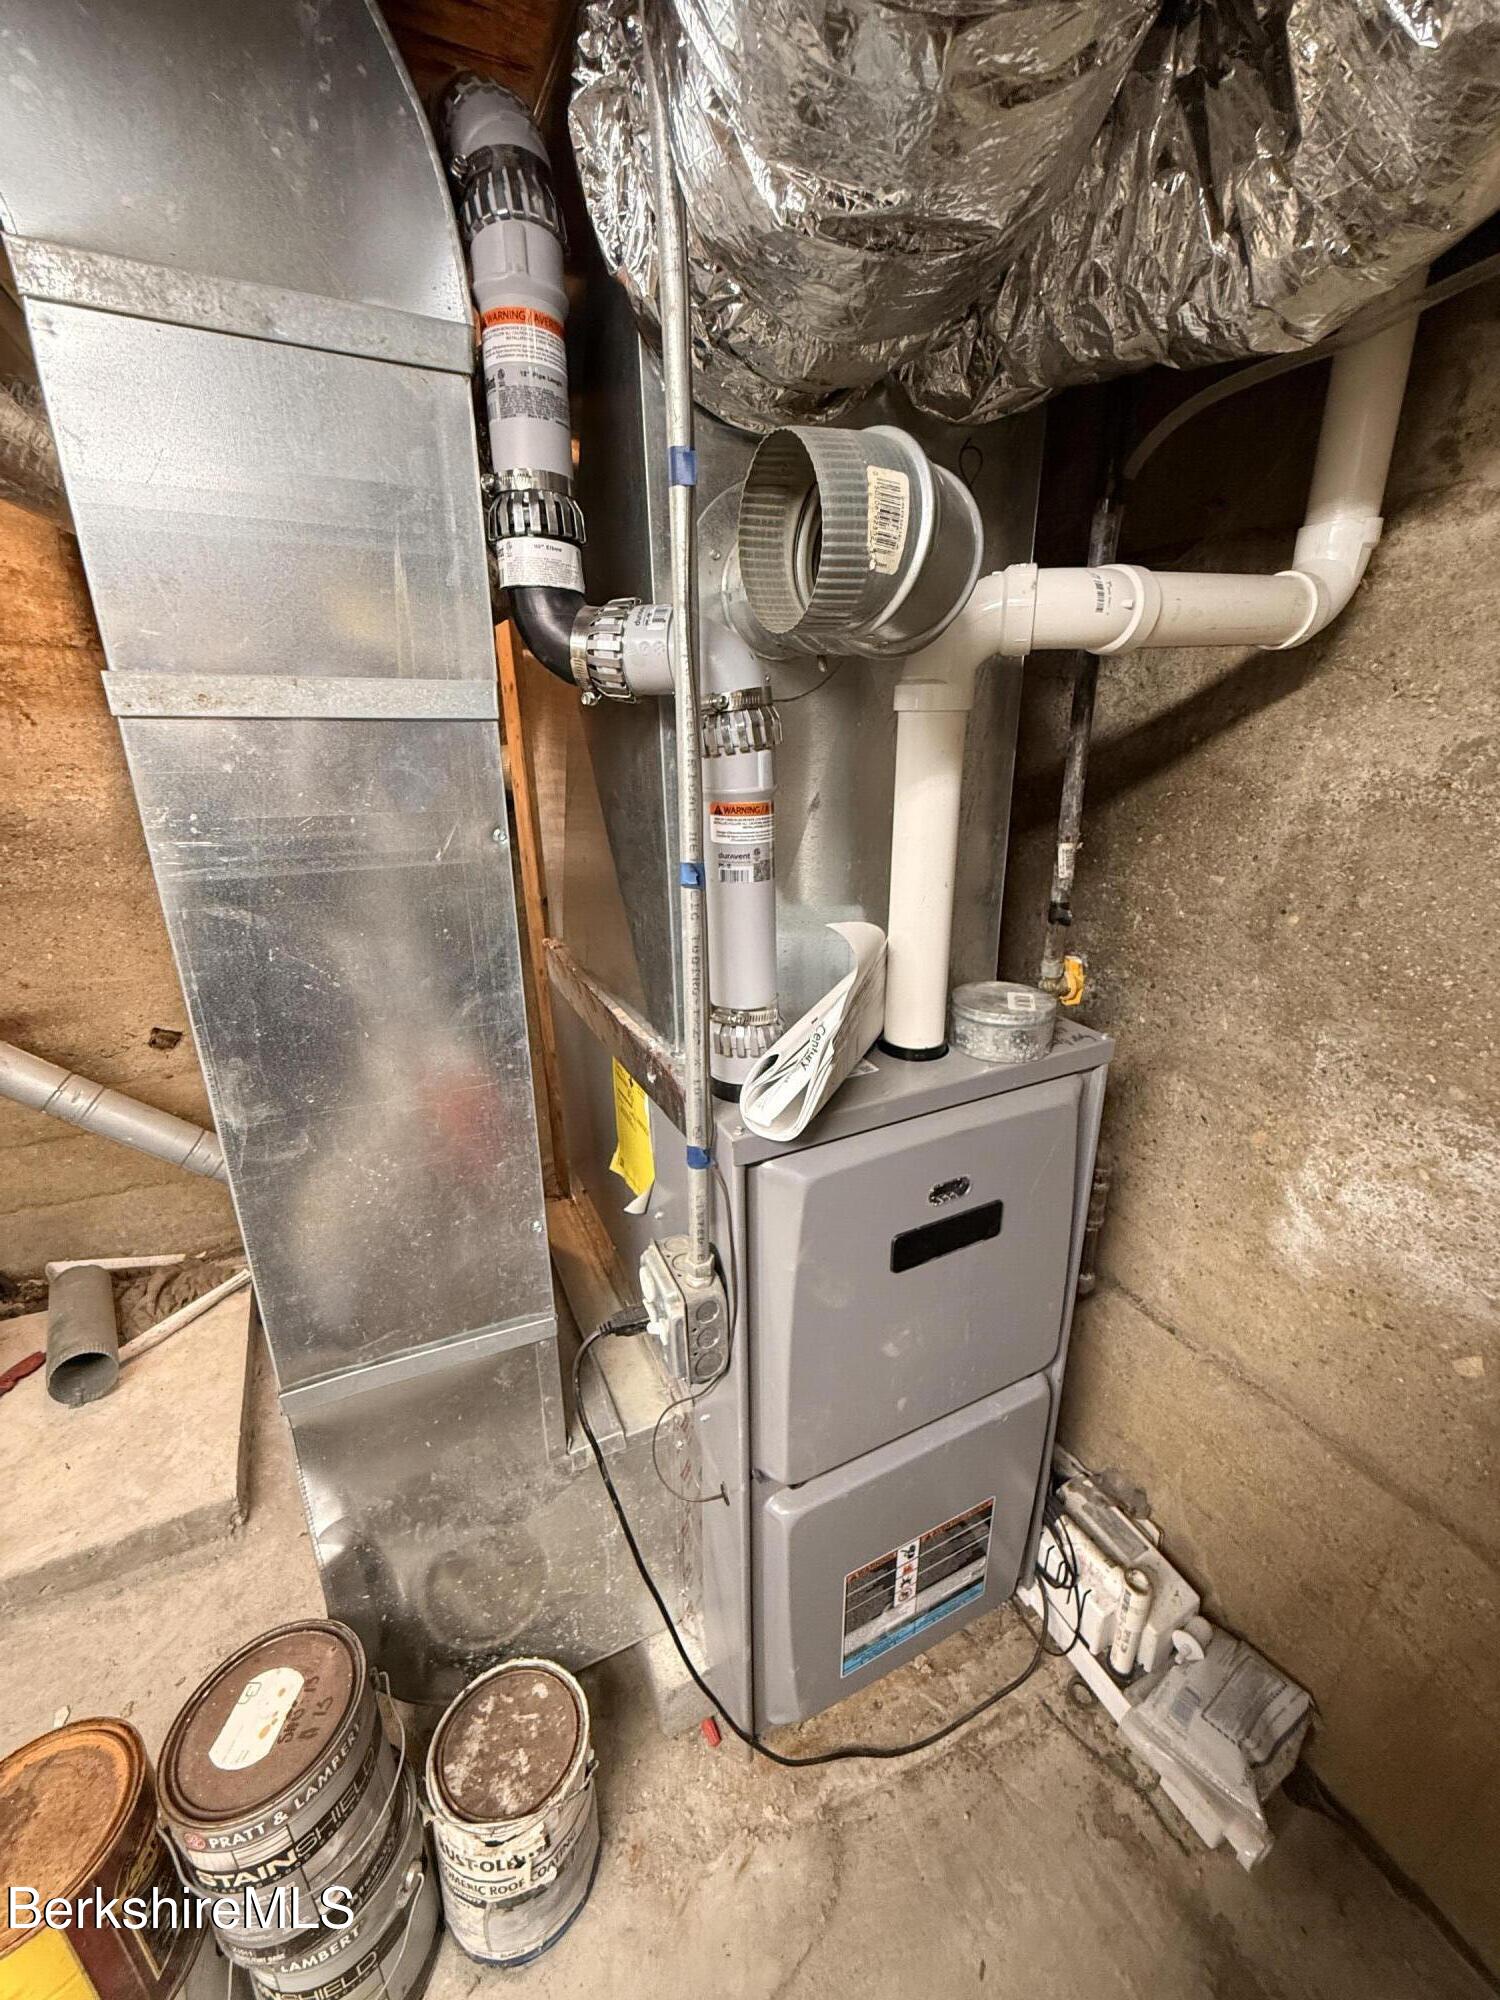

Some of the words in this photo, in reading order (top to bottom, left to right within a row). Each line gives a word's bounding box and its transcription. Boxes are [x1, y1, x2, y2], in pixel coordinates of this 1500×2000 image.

[723, 804, 760, 814] WARNING
[718, 851, 750, 860] duravent
[802, 1023, 826, 1071] Century
[209, 1823, 266, 1849] PRATT
[273, 1810, 290, 1827] &
[489, 1878, 526, 1896] ROOF
[281, 1924, 361, 1974] LAMBERT
